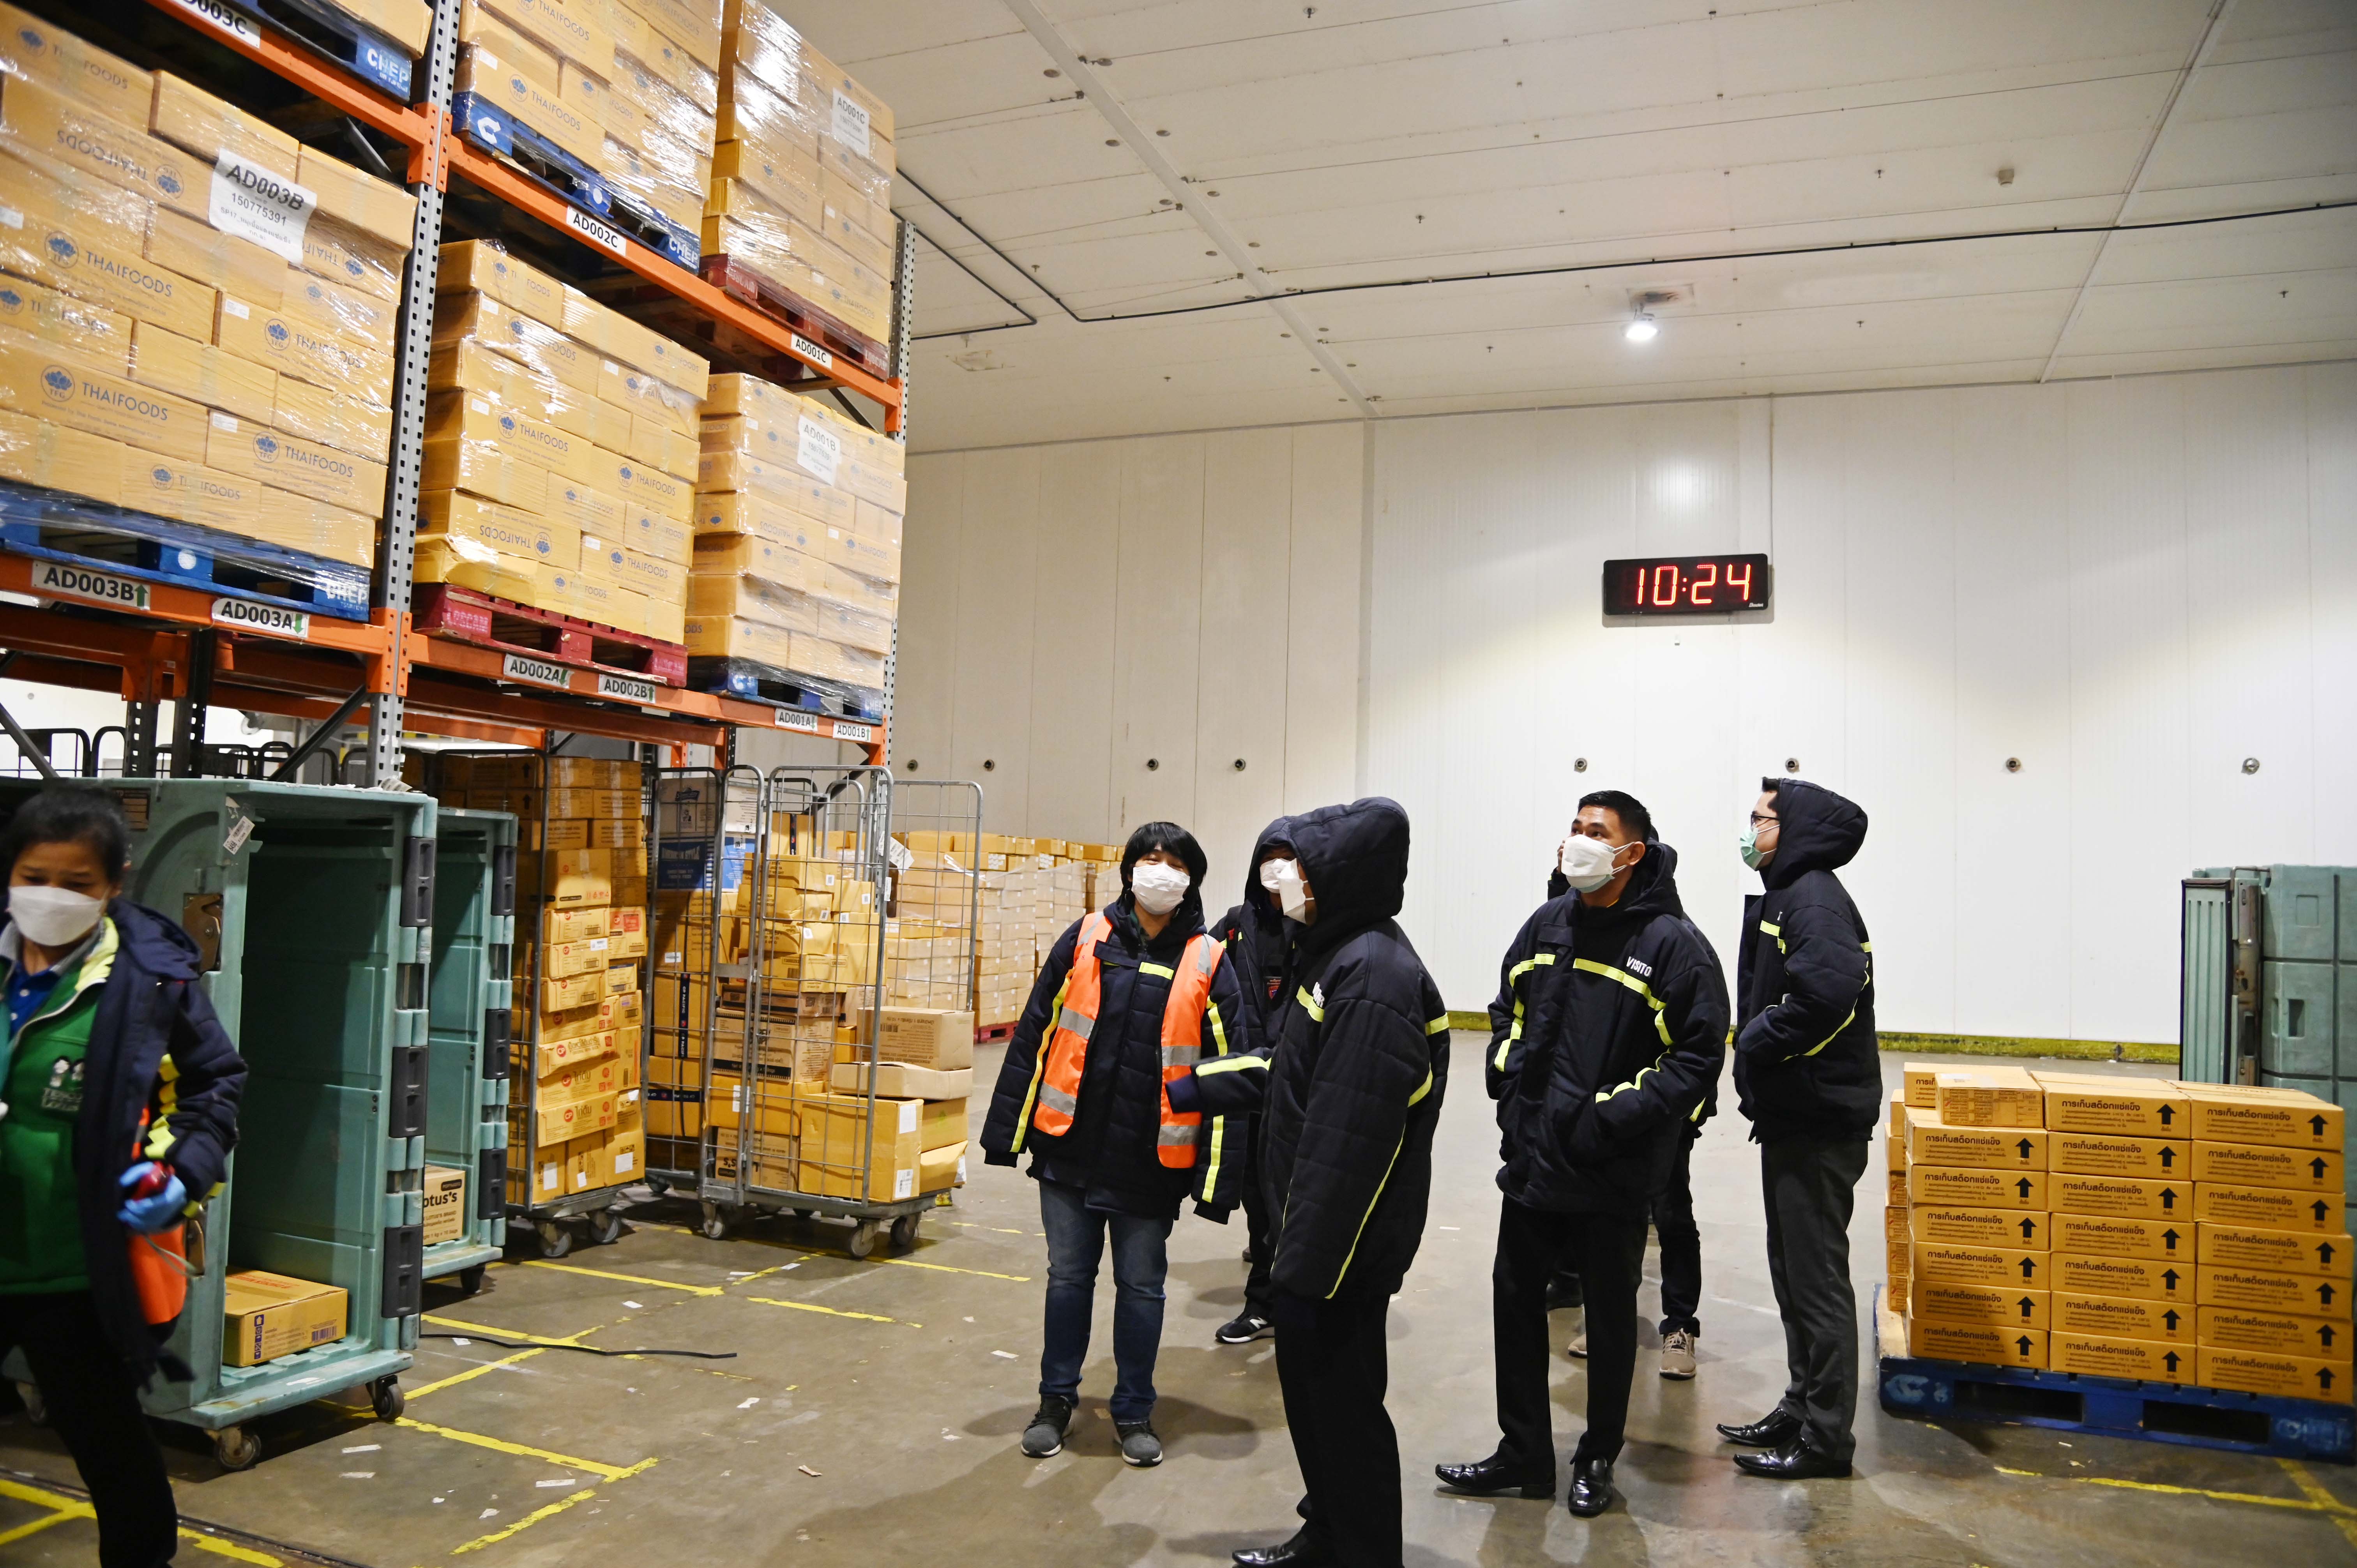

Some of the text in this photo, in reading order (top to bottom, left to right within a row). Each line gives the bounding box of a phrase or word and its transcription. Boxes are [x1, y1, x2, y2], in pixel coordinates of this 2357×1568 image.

[539, 1, 590, 41] THAIFOODS
[53, 44, 128, 89] TFOODS
[367, 48, 409, 83] CHEP
[532, 90, 581, 131] THAIFOODS
[597, 90, 633, 119] TIFOODS
[837, 97, 865, 125] AD001C
[226, 165, 304, 211] AD003B
[232, 192, 287, 226] 150775391
[573, 212, 618, 249] AD002C
[302, 241, 339, 266] THAIF
[669, 236, 699, 262] CHEP
[86, 251, 173, 298] THAIFOODS
[511, 270, 551, 297] TFOODS
[666, 351, 700, 373] TIFOODS
[795, 339, 827, 364] AD001C
[49, 390, 66, 399] TFG
[82, 382, 168, 421] THAIFOODS
[520, 424, 569, 452] THAIFOODS
[804, 424, 836, 451] AD001B
[259, 451, 272, 461] TFG
[286, 445, 354, 478] THAIFOODS
[179, 475, 240, 500] TIFOODS
[636, 473, 676, 496] THAIFOODS
[580, 494, 614, 515] TIFOODS
[479, 524, 531, 549] THAIFOODS
[653, 523, 685, 540] TFOODS
[627, 557, 668, 579] THAIFOODS
[44, 567, 134, 601] AD003B
[570, 581, 607, 599] TFOODS
[1636, 563, 1752, 606] 10:24
[221, 601, 292, 629] AD003A
[509, 660, 559, 682] AD002A
[604, 679, 647, 699] AD002B
[779, 712, 811, 726] AD001A
[837, 726, 866, 738] AD001B
[1626, 955, 1653, 977] VISITO
[424, 1191, 458, 1208] otus's
